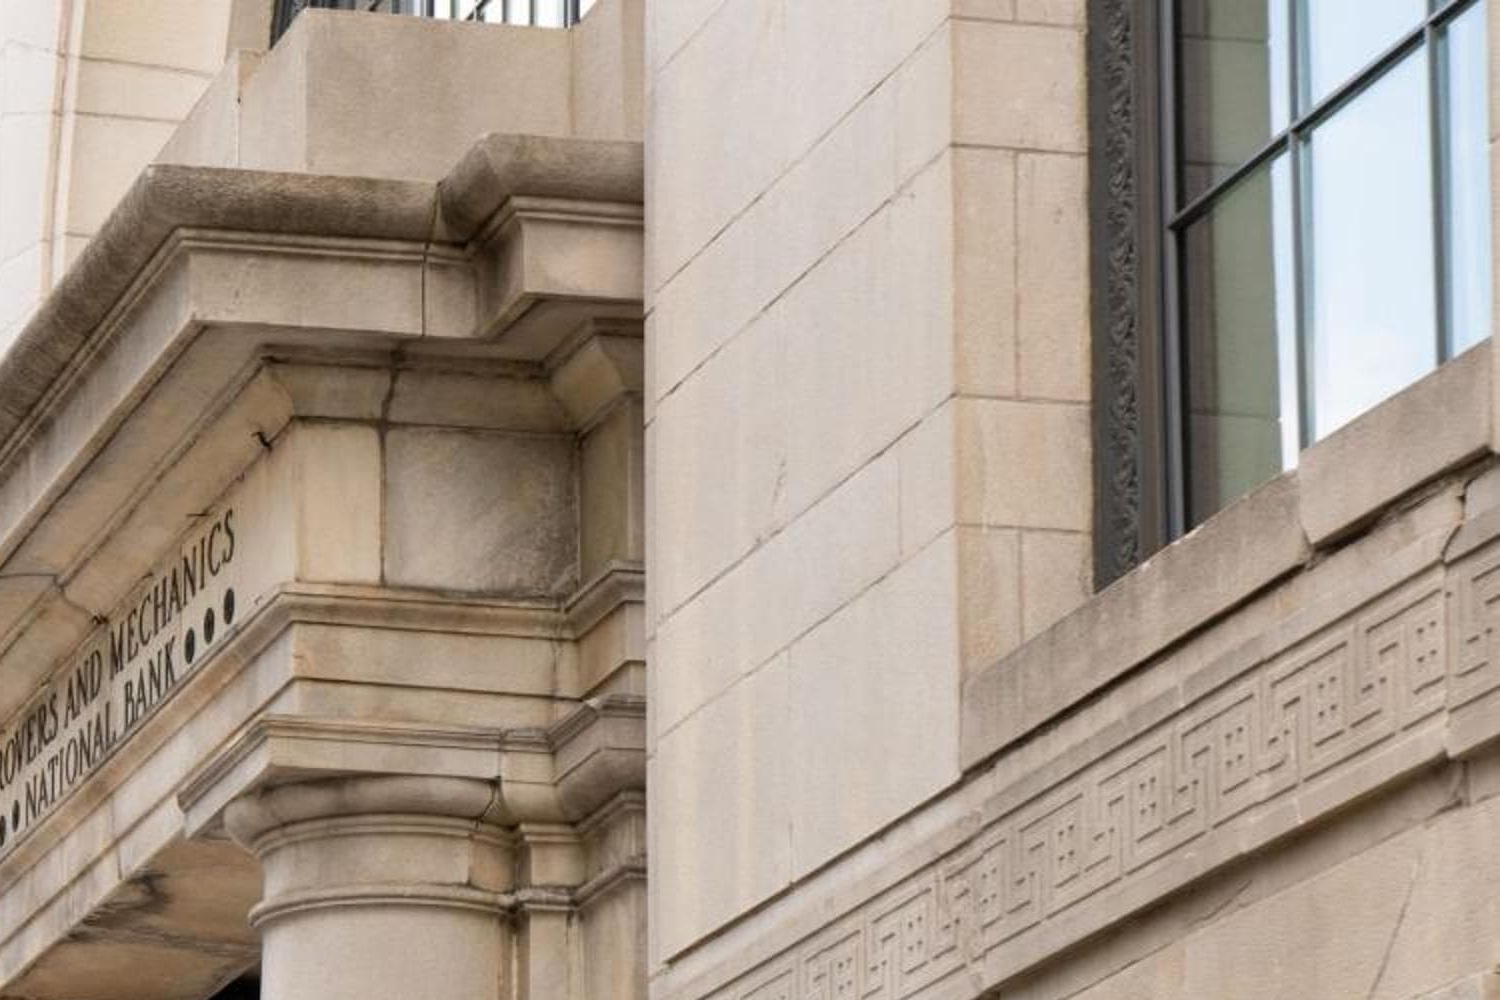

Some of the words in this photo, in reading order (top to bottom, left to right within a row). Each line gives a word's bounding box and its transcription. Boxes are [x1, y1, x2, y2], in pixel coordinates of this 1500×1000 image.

[64, 650, 102, 729] AND
[109, 508, 235, 682] MECHANICS
[26, 701, 117, 827] NATIONAL
[124, 635, 177, 733] BANK
